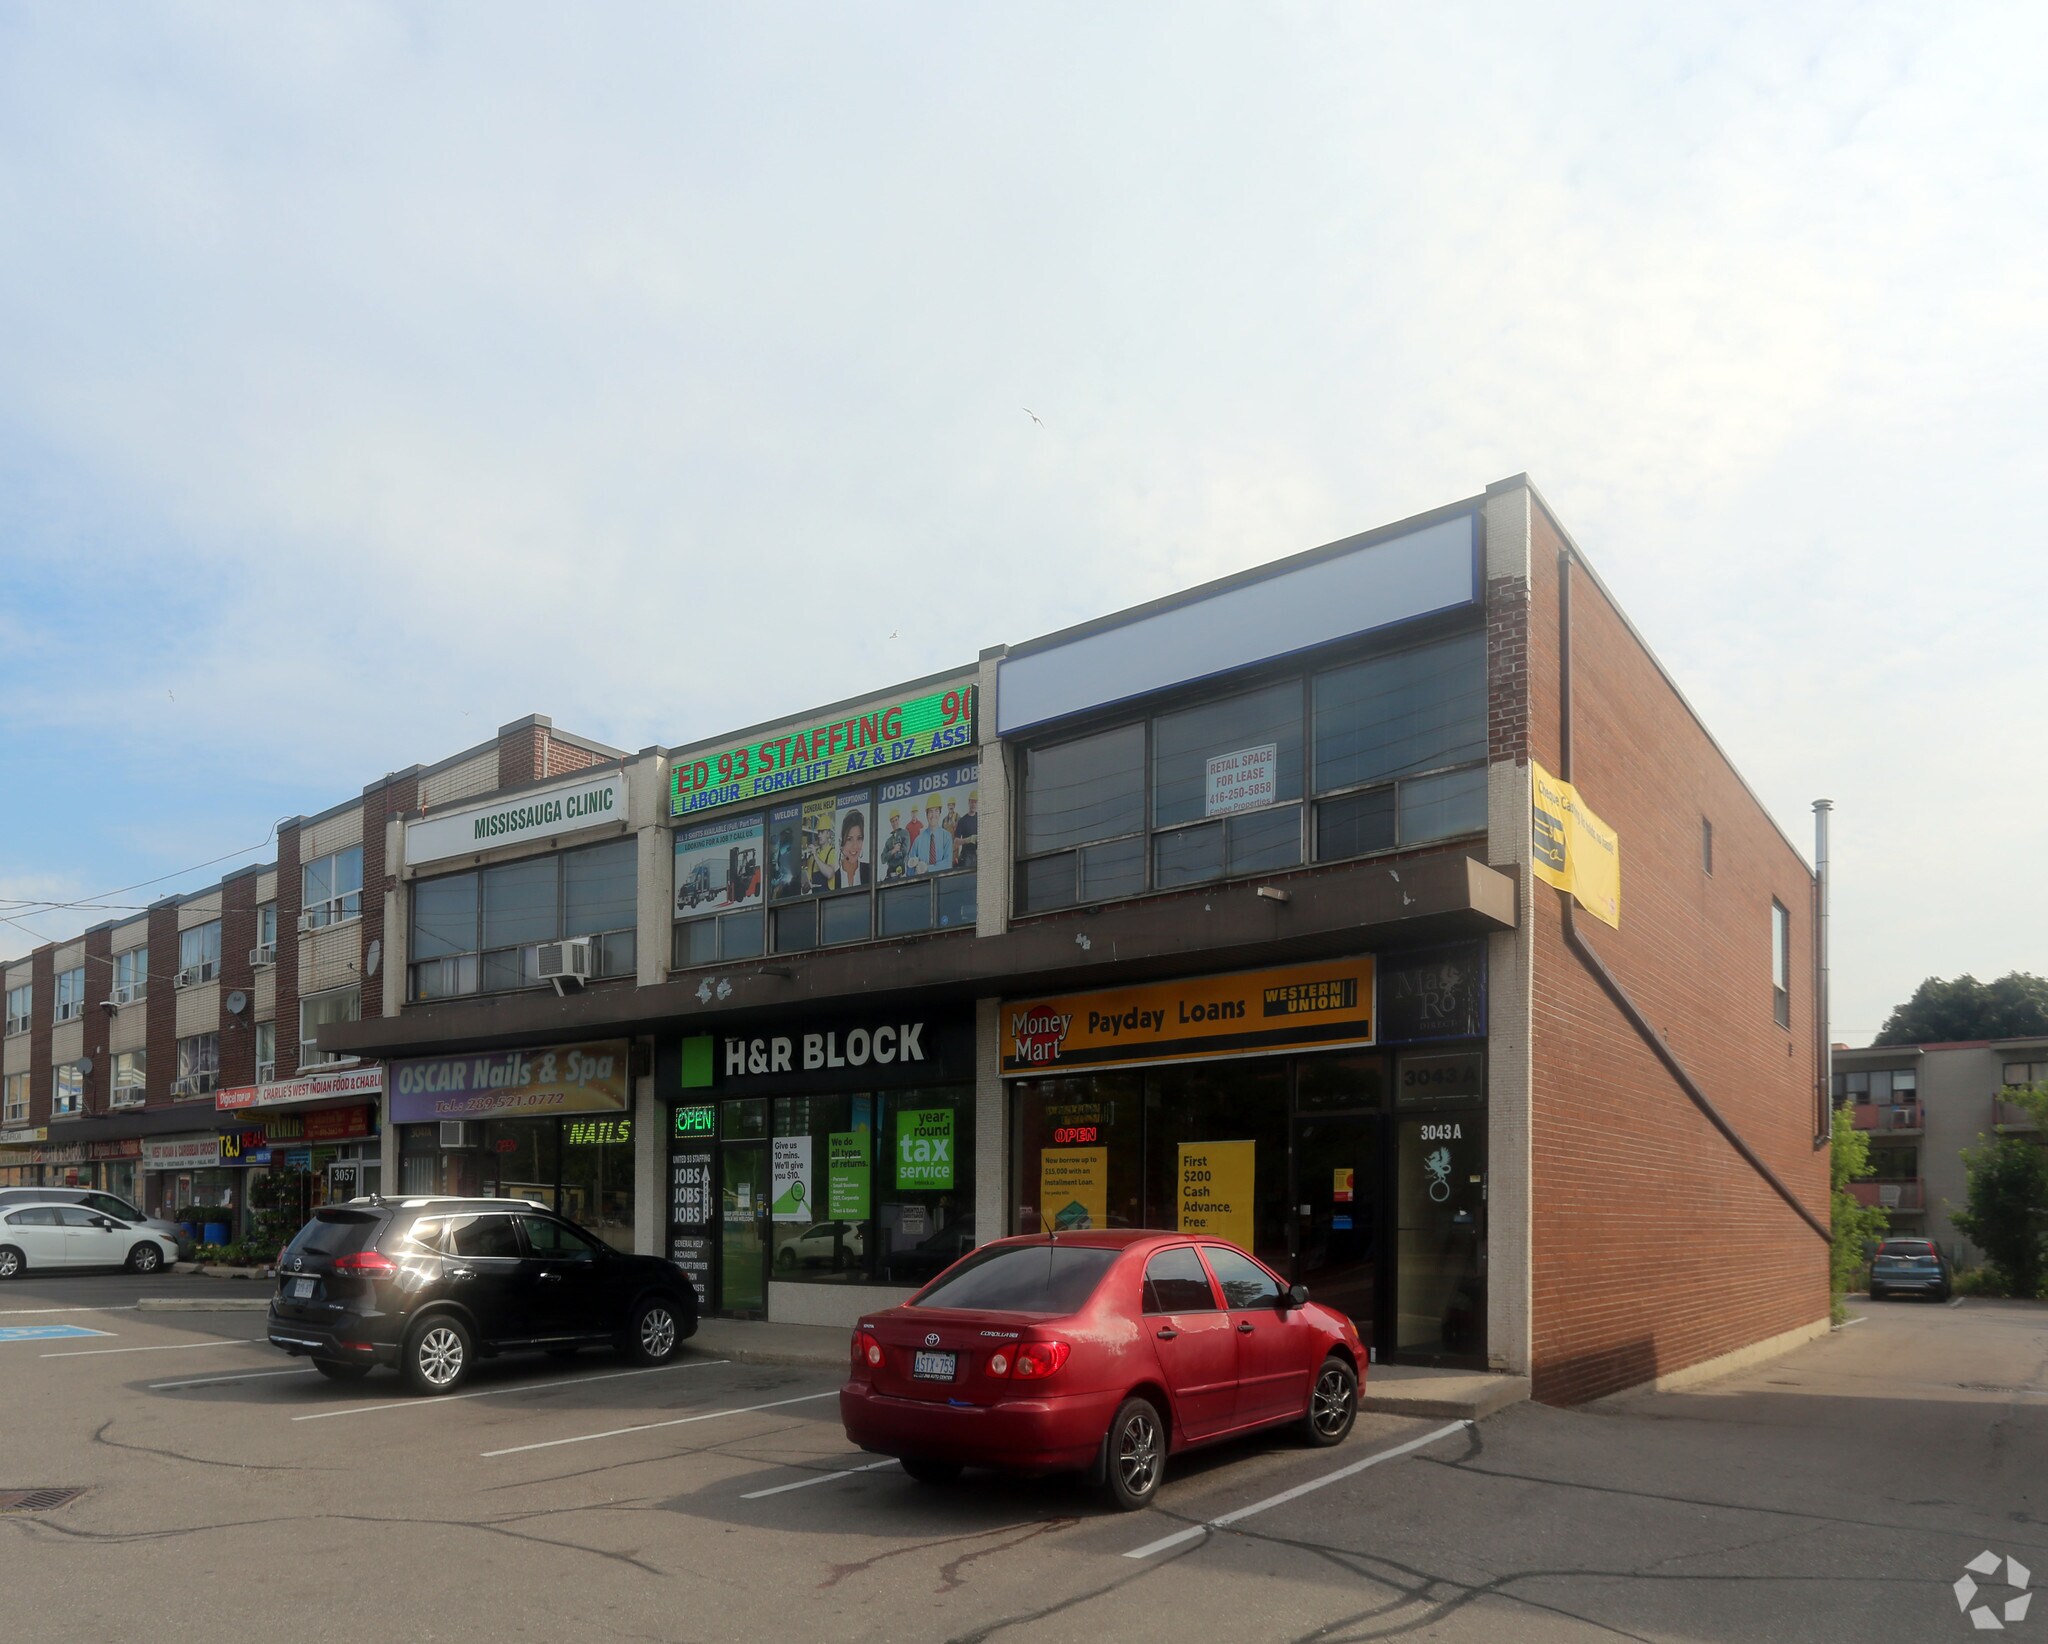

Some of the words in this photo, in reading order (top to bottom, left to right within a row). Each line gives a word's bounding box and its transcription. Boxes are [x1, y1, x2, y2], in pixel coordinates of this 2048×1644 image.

[718, 748, 750, 784] 93
[758, 707, 902, 774] STAFFING
[1210, 758, 1240, 775] RETAIL
[1242, 750, 1273, 767] SPACE
[682, 783, 740, 812] LABOUR
[753, 759, 832, 795] FORKLIFT
[846, 752, 868, 773] AZ
[872, 746, 886, 765] &
[892, 738, 916, 760] DZ
[1216, 775, 1234, 788] FOR
[1236, 767, 1265, 783] LEASE
[882, 781, 912, 801] JOBS
[918, 772, 949, 792] JOBS
[1209, 782, 1272, 805] 416-250-5858
[804, 802, 823, 814] GENERAL
[823, 800, 834, 810] HELP
[837, 792, 869, 807] RECEPTIONIST
[474, 799, 562, 839] MISSISSAUGA
[566, 787, 613, 819] CLINIC
[774, 808, 799, 820] WELDER
[685, 840, 705, 851] LOOKING
[733, 831, 745, 841] CALL
[746, 829, 753, 838] US
[688, 830, 704, 840] SHIFTS
[704, 824, 727, 835] AVAILABLE
[1264, 982, 1341, 1003] WESTERN
[1287, 994, 1341, 1014] UNION
[1011, 1009, 1073, 1041] Money
[1088, 1008, 1166, 1037] Payday
[1178, 999, 1246, 1026] Loans
[725, 1036, 792, 1076] H&R
[803, 1022, 925, 1070] BLOCK
[1014, 1036, 1062, 1063] Mart
[398, 1061, 468, 1095] OSCAR
[472, 1052, 532, 1090] Nails
[539, 1052, 557, 1085] &
[565, 1049, 614, 1088] Spa
[263, 1084, 292, 1100] CHARLIE'S
[293, 1082, 310, 1097] WEST
[310, 1080, 332, 1096] INDIAN
[333, 1078, 350, 1092] FOOD
[351, 1077, 356, 1090] &
[467, 1092, 565, 1111] 289.521.0772
[677, 1108, 712, 1131] OPEN
[918, 1112, 950, 1126] year-
[568, 1119, 632, 1145] NAILS
[914, 1122, 950, 1137] round
[1054, 1126, 1098, 1143] OPEN
[200, 1141, 218, 1156] GROCERY
[218, 1135, 240, 1157] T&J
[774, 1141, 789, 1150] Give
[790, 1142, 798, 1150] us
[831, 1138, 844, 1147] We
[844, 1137, 853, 1146] do
[899, 1133, 950, 1163] tax
[672, 1155, 687, 1165] UNITED
[692, 1153, 711, 1164] STAFFING
[774, 1152, 782, 1160] 10
[783, 1151, 800, 1160] mins.
[831, 1148, 840, 1157] all
[841, 1149, 861, 1159] types
[1045, 1156, 1058, 1164] Now
[1058, 1156, 1080, 1164] borrow
[1081, 1157, 1088, 1165] up
[1183, 1155, 1208, 1167] First
[774, 1161, 790, 1170] We'll
[790, 1161, 804, 1172] give
[831, 1160, 838, 1169] of
[840, 1160, 868, 1169] returns.
[900, 1162, 950, 1179] service
[1045, 1167, 1068, 1176] $15,000
[1068, 1167, 1082, 1175] with
[334, 1169, 355, 1182] 3057
[674, 1167, 700, 1185] JOBS
[774, 1173, 786, 1182] you
[787, 1171, 800, 1180] $10.
[1045, 1178, 1078, 1186] Installment
[1183, 1170, 1211, 1183] $200
[674, 1187, 700, 1204] JOBS
[1183, 1186, 1210, 1197] Cash
[674, 1206, 700, 1223] JOBS
[1183, 1201, 1233, 1214] Advance,
[674, 1239, 692, 1249] GENERAL
[693, 1239, 704, 1249] HELP
[674, 1250, 698, 1260] PACKAGING
[692, 1261, 708, 1271] DRIVER
